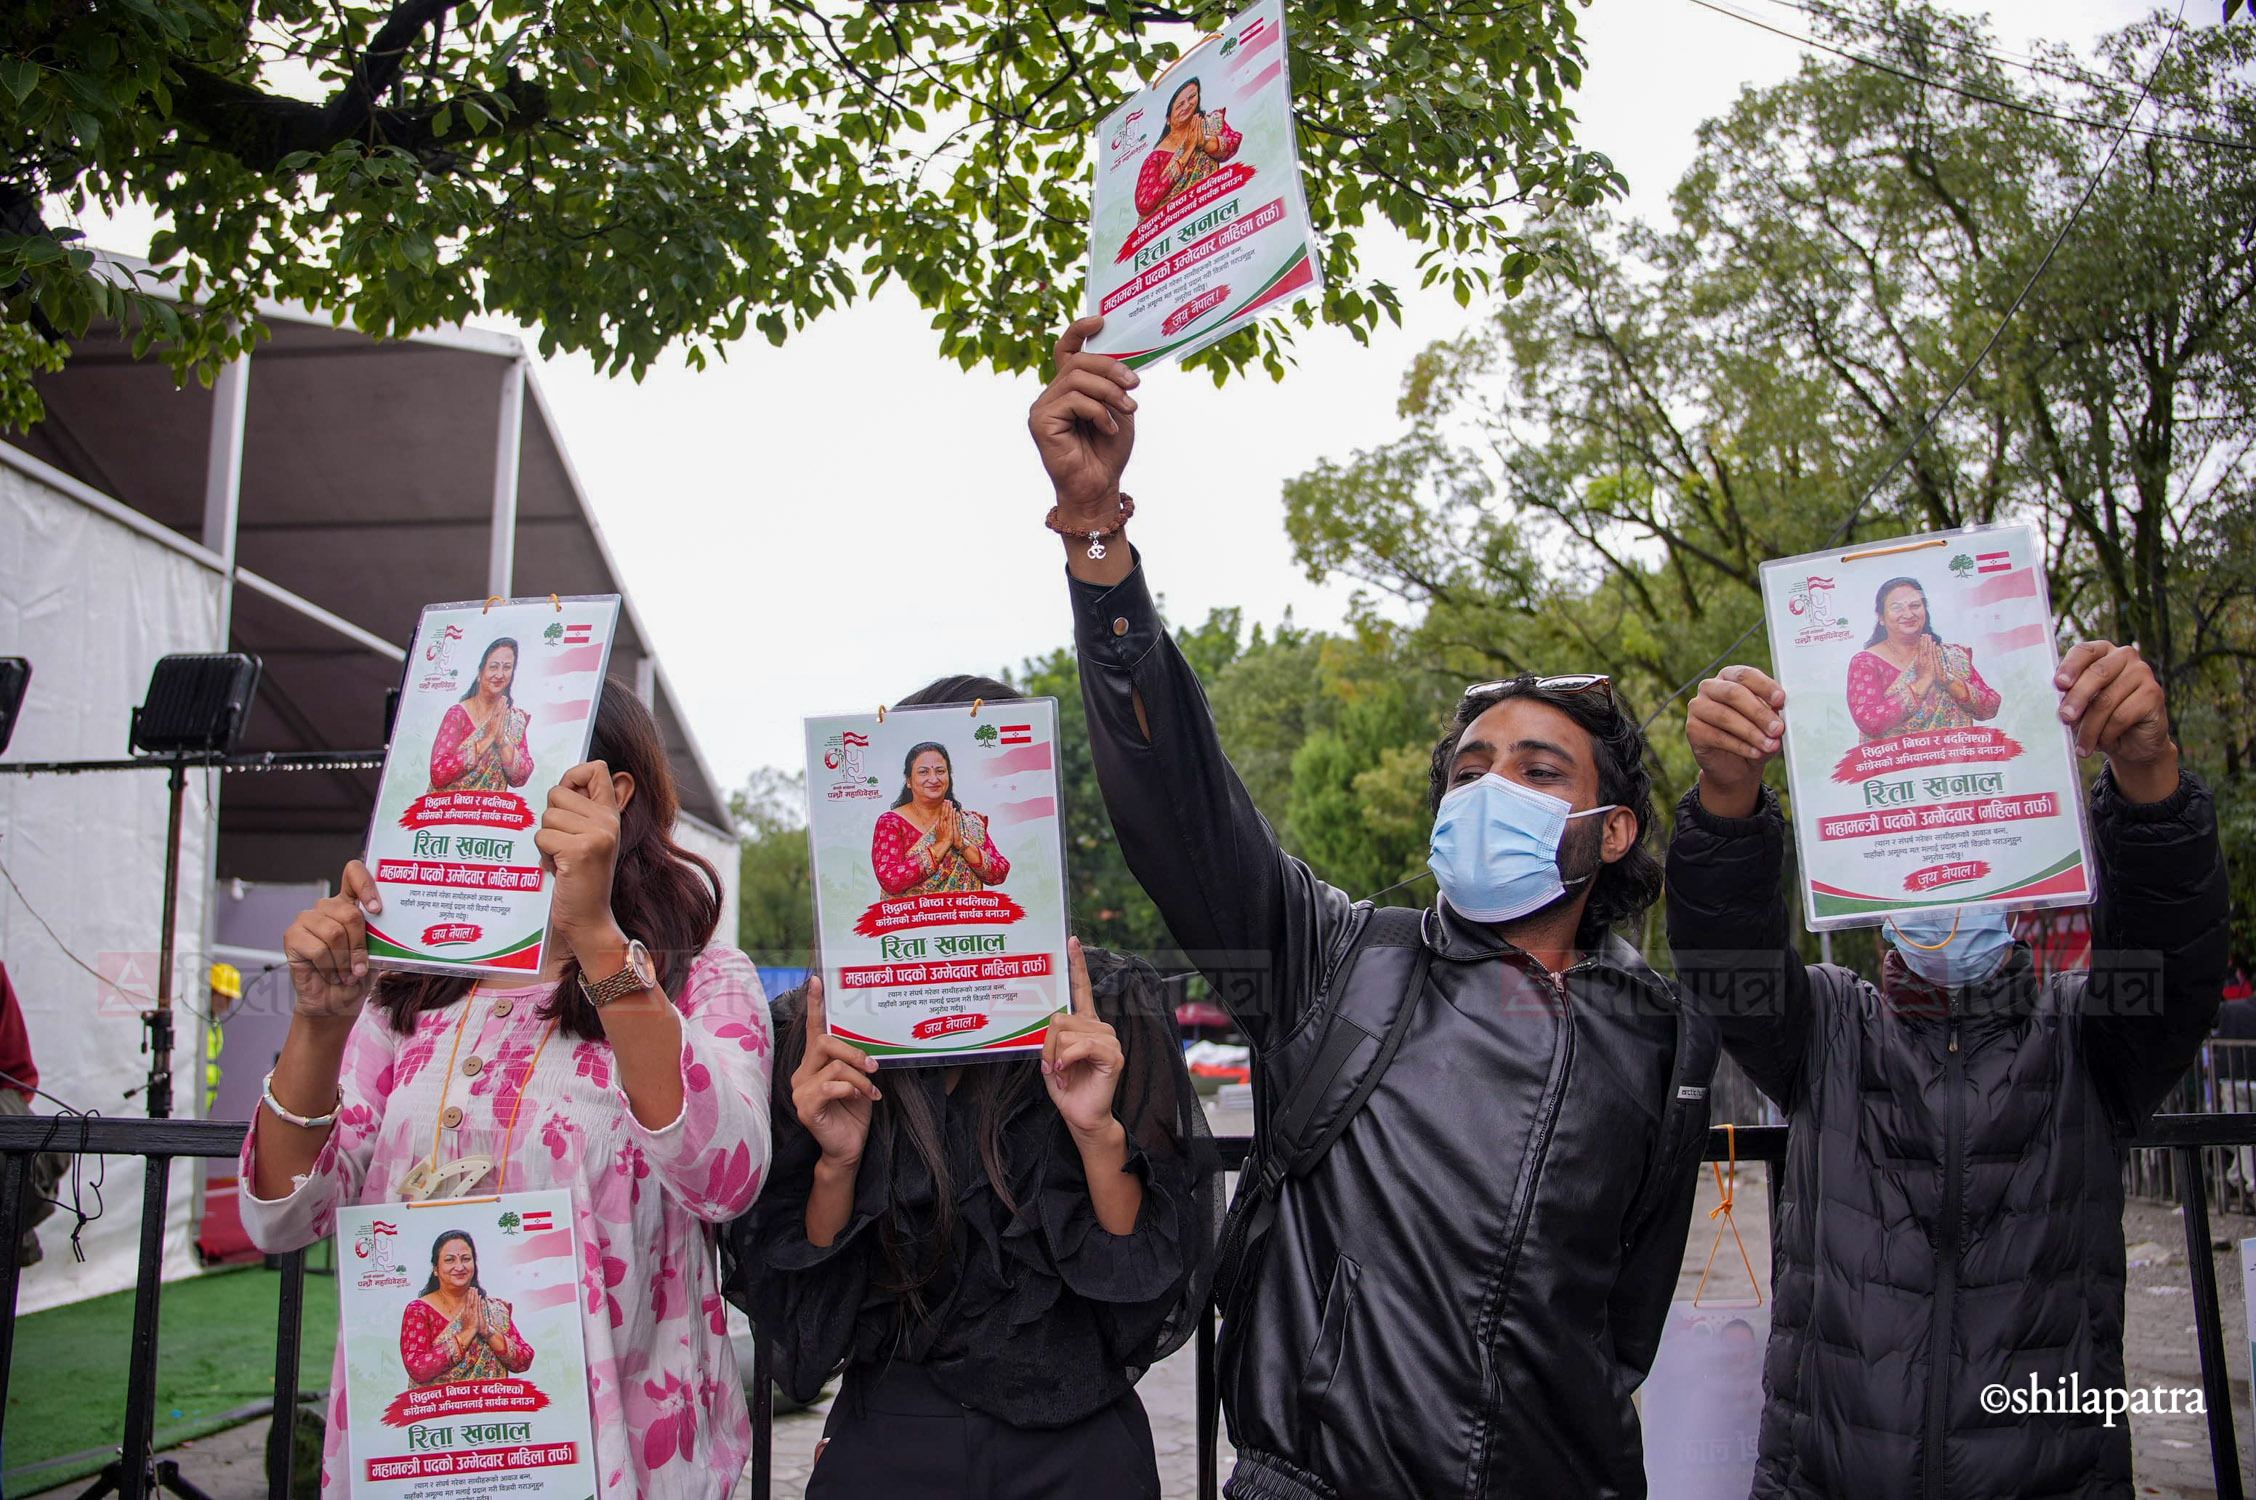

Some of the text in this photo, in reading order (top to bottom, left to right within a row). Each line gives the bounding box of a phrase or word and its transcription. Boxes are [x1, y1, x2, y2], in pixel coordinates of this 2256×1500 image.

[1902, 737, 1930, 749] निष्ठा
[1943, 732, 1992, 744] बदलिएको
[1895, 748, 1946, 765] अभियानलाई
[1947, 745, 1975, 758] सार्थक
[1977, 745, 2006, 755] बनाउन
[1863, 772, 2003, 805] रिता खनाल
[482, 795, 517, 811] बदलिएको
[482, 810, 502, 820] सार्थक
[502, 813, 523, 823] बनाउन
[1826, 794, 2052, 836] महामन्त्री पदको उम्मेदवार (महिला तर्फ)
[413, 830, 514, 858] रिता खनाल
[381, 863, 419, 881] महामन्त्री
[421, 864, 445, 882] पदको
[446, 866, 486, 885] उम्मेदवार
[1918, 871, 1938, 885] जय
[919, 897, 944, 908] निष्ठा
[956, 895, 999, 907] बदलिएको
[875, 913, 909, 927] कांग्रेसको
[911, 909, 957, 922] अभियानलाई
[958, 908, 983, 919] सार्थक
[432, 928, 447, 940] जय
[881, 934, 1005, 958] रिता खनाल
[845, 956, 1046, 986] महामन्त्री पदको उम्मेदवार (महिला तर्फ)
[929, 996, 944, 1005] मलाई
[925, 1021, 943, 1034] जय
[446, 1386, 470, 1396] निष्ठा
[482, 1382, 524, 1394] बदलिएको
[438, 1397, 483, 1411] अभियानलाई
[484, 1396, 509, 1407] सार्थक
[510, 1397, 535, 1405] बनाउन
[408, 1422, 530, 1448] रिता खनाल
[372, 1457, 420, 1477] महामन्त्री
[423, 1454, 453, 1473] पदको
[456, 1452, 504, 1470] उम्मेदवार
[508, 1447, 545, 1466] (महिला
